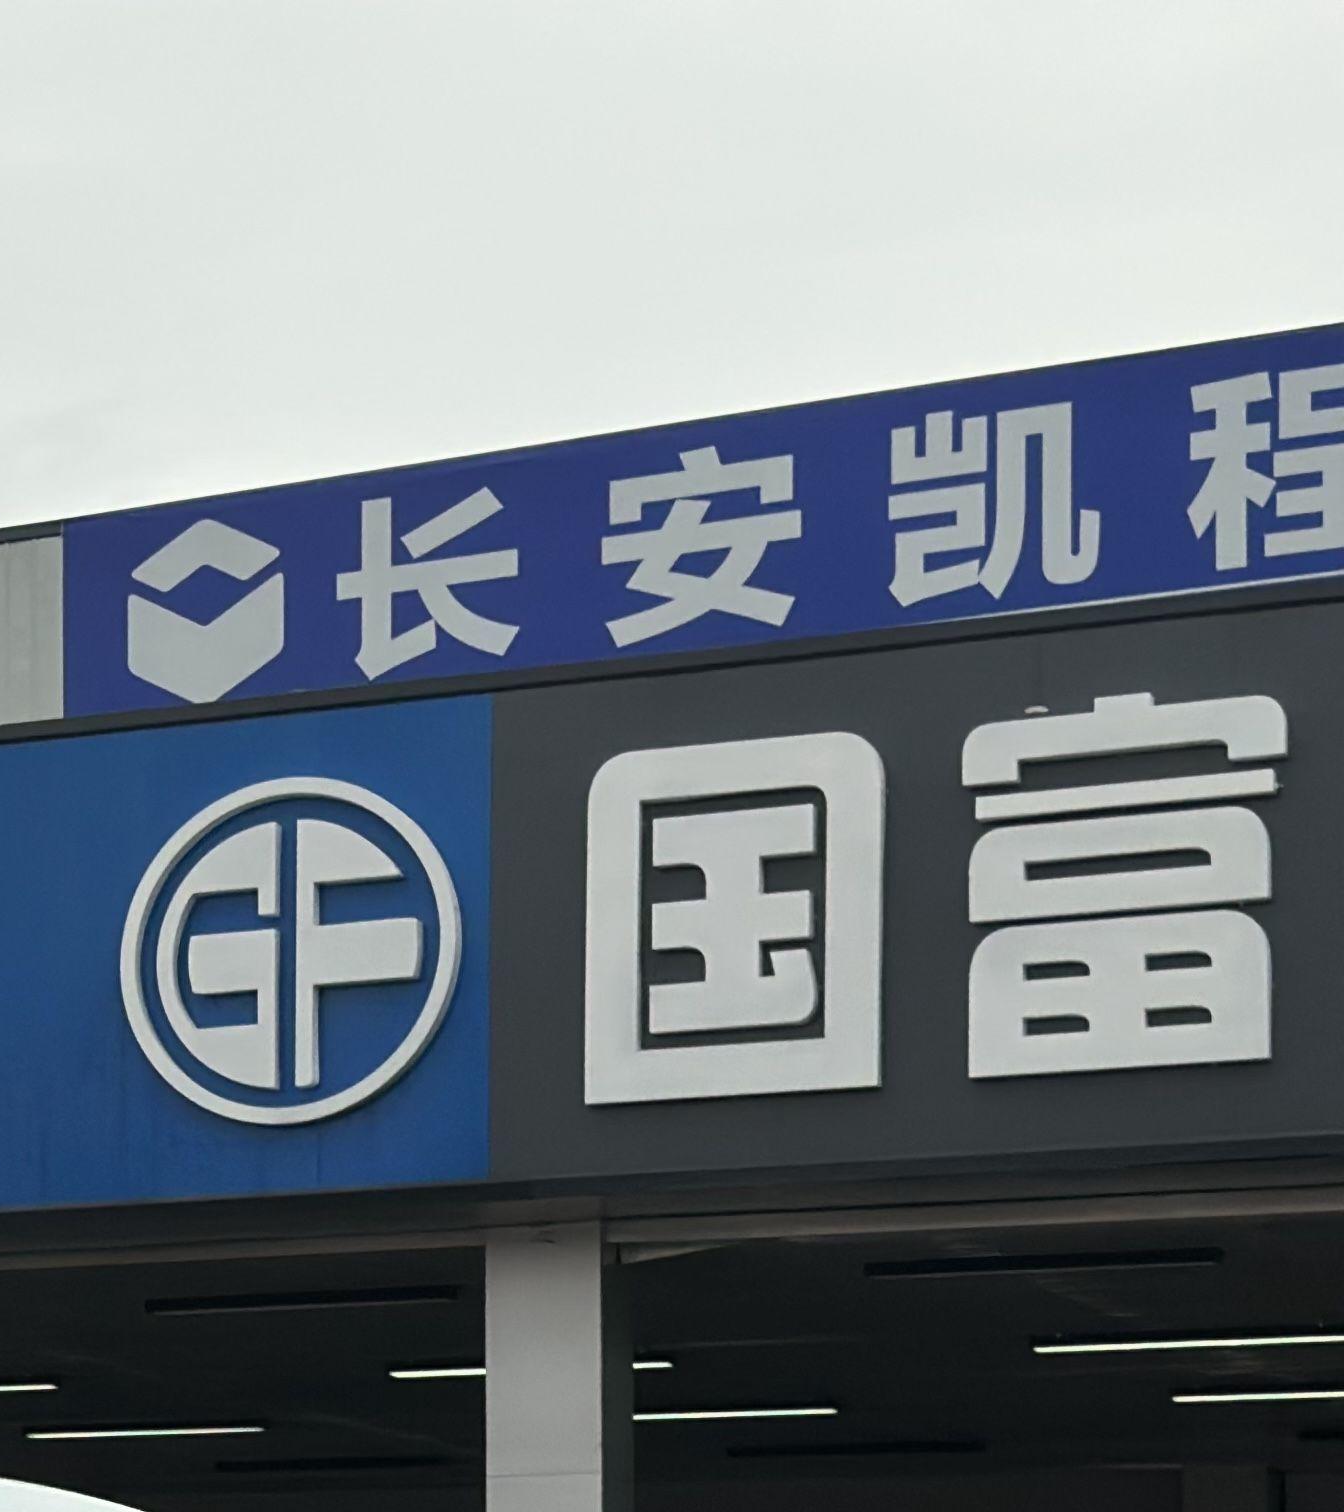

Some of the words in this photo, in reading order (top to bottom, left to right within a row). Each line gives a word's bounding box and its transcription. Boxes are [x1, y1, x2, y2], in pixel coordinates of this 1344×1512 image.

[336, 363, 1344, 680] 长安凯程
[584, 690, 1289, 1106] 国富
